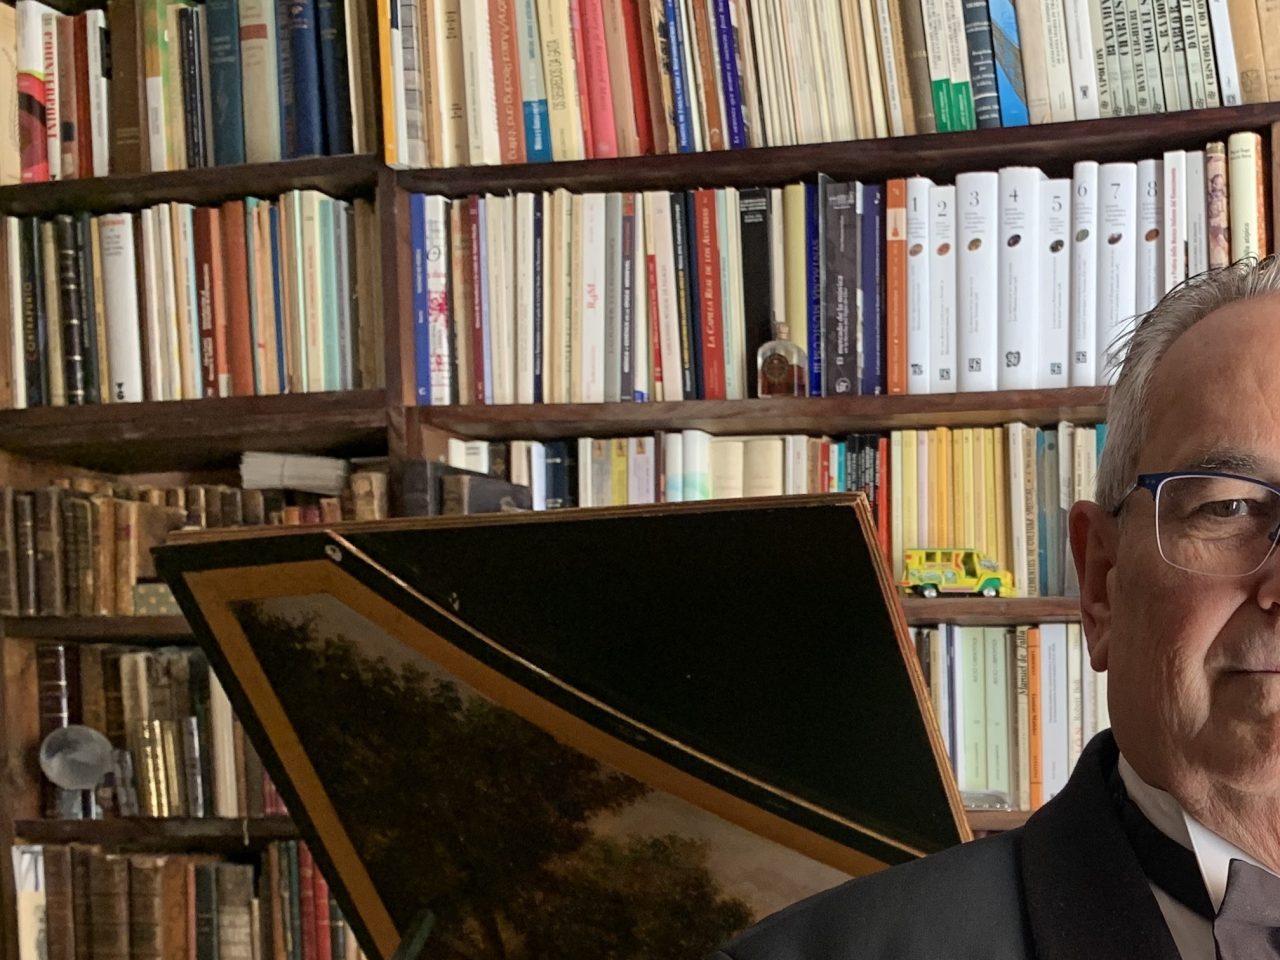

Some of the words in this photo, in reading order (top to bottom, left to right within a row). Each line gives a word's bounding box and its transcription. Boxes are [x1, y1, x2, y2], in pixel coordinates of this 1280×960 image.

[1141, 12, 1154, 53] MIGUEL
[1184, 15, 1197, 49] DAVID
[44, 32, 57, 139] COUNTERPOINT
[1135, 62, 1145, 92] DANTE
[969, 190, 979, 207] 3
[1110, 182, 1120, 199] 7
[1146, 181, 1157, 197] 8
[1051, 196, 1062, 212] 5
